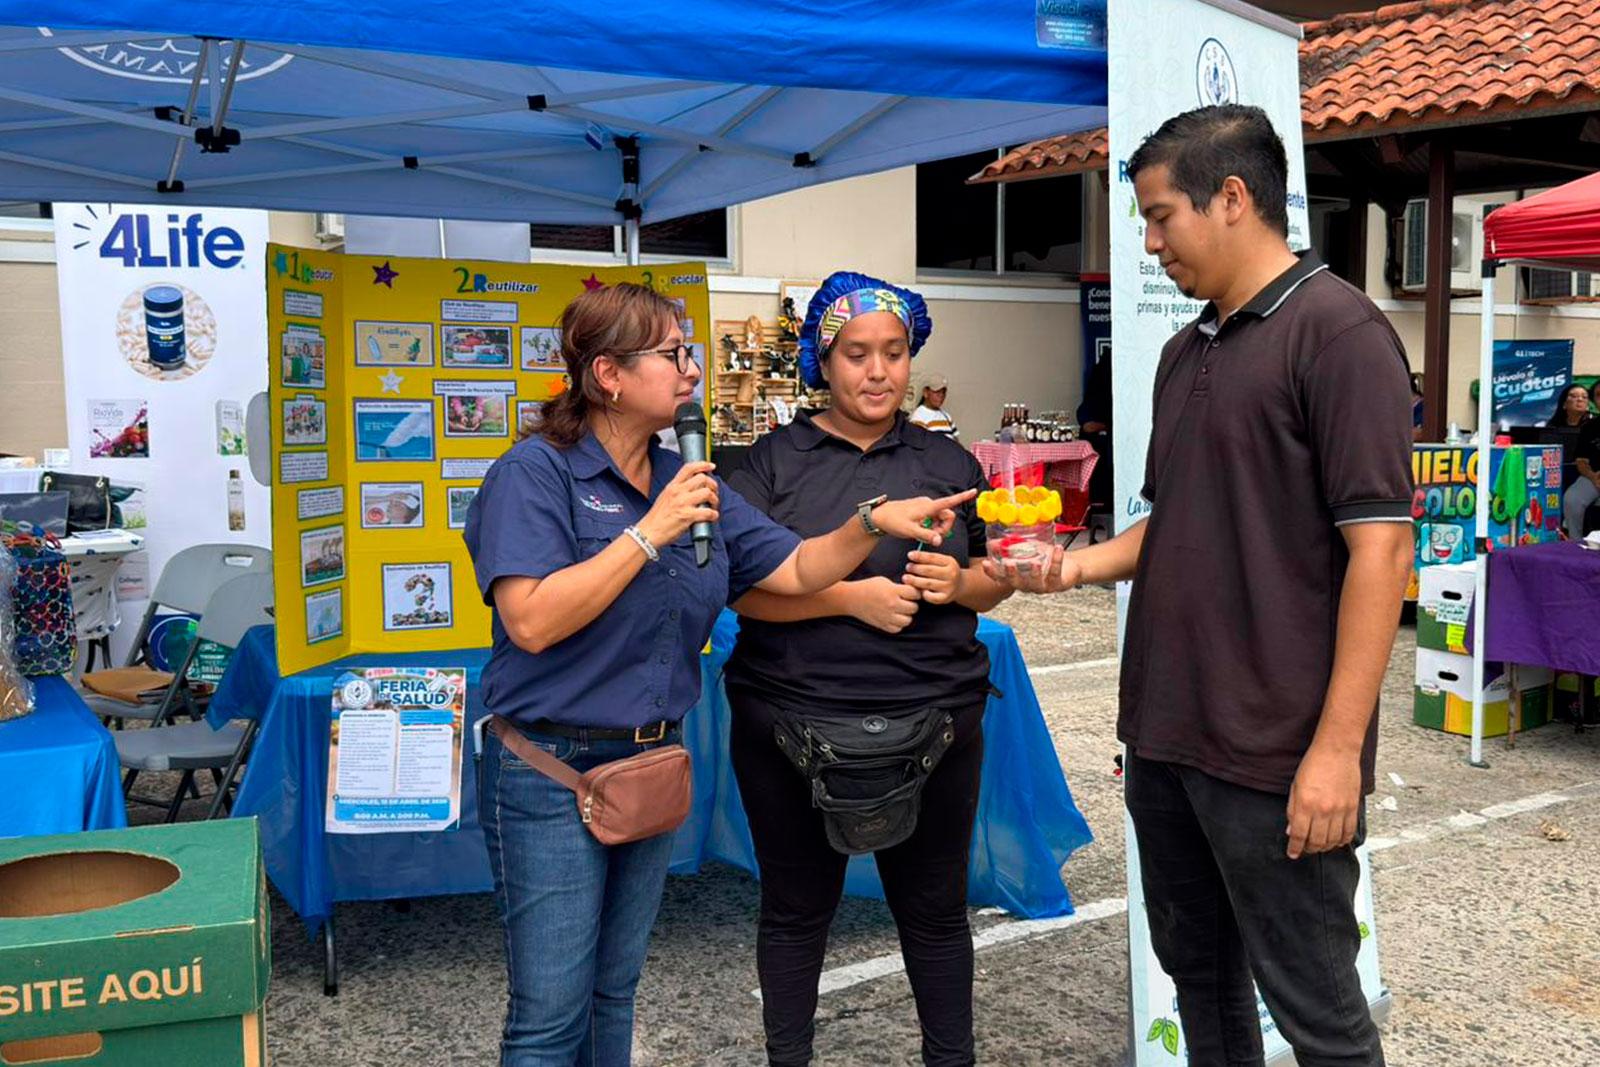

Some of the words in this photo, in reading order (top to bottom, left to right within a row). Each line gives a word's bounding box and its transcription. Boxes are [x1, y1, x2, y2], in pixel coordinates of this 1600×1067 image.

[100, 213, 245, 268] 4Life
[1139, 260, 1156, 275] Esta
[453, 266, 474, 293] 2
[473, 273, 540, 294] Reutilizar
[1137, 299, 1162, 316] primas
[1164, 304, 1169, 317] y
[1089, 313, 1111, 322] nues
[1494, 374, 1566, 397] Cuotas
[380, 680, 427, 692] FERIA
[391, 693, 447, 705] SALUD
[98, 957, 203, 1005] AQUÍ
